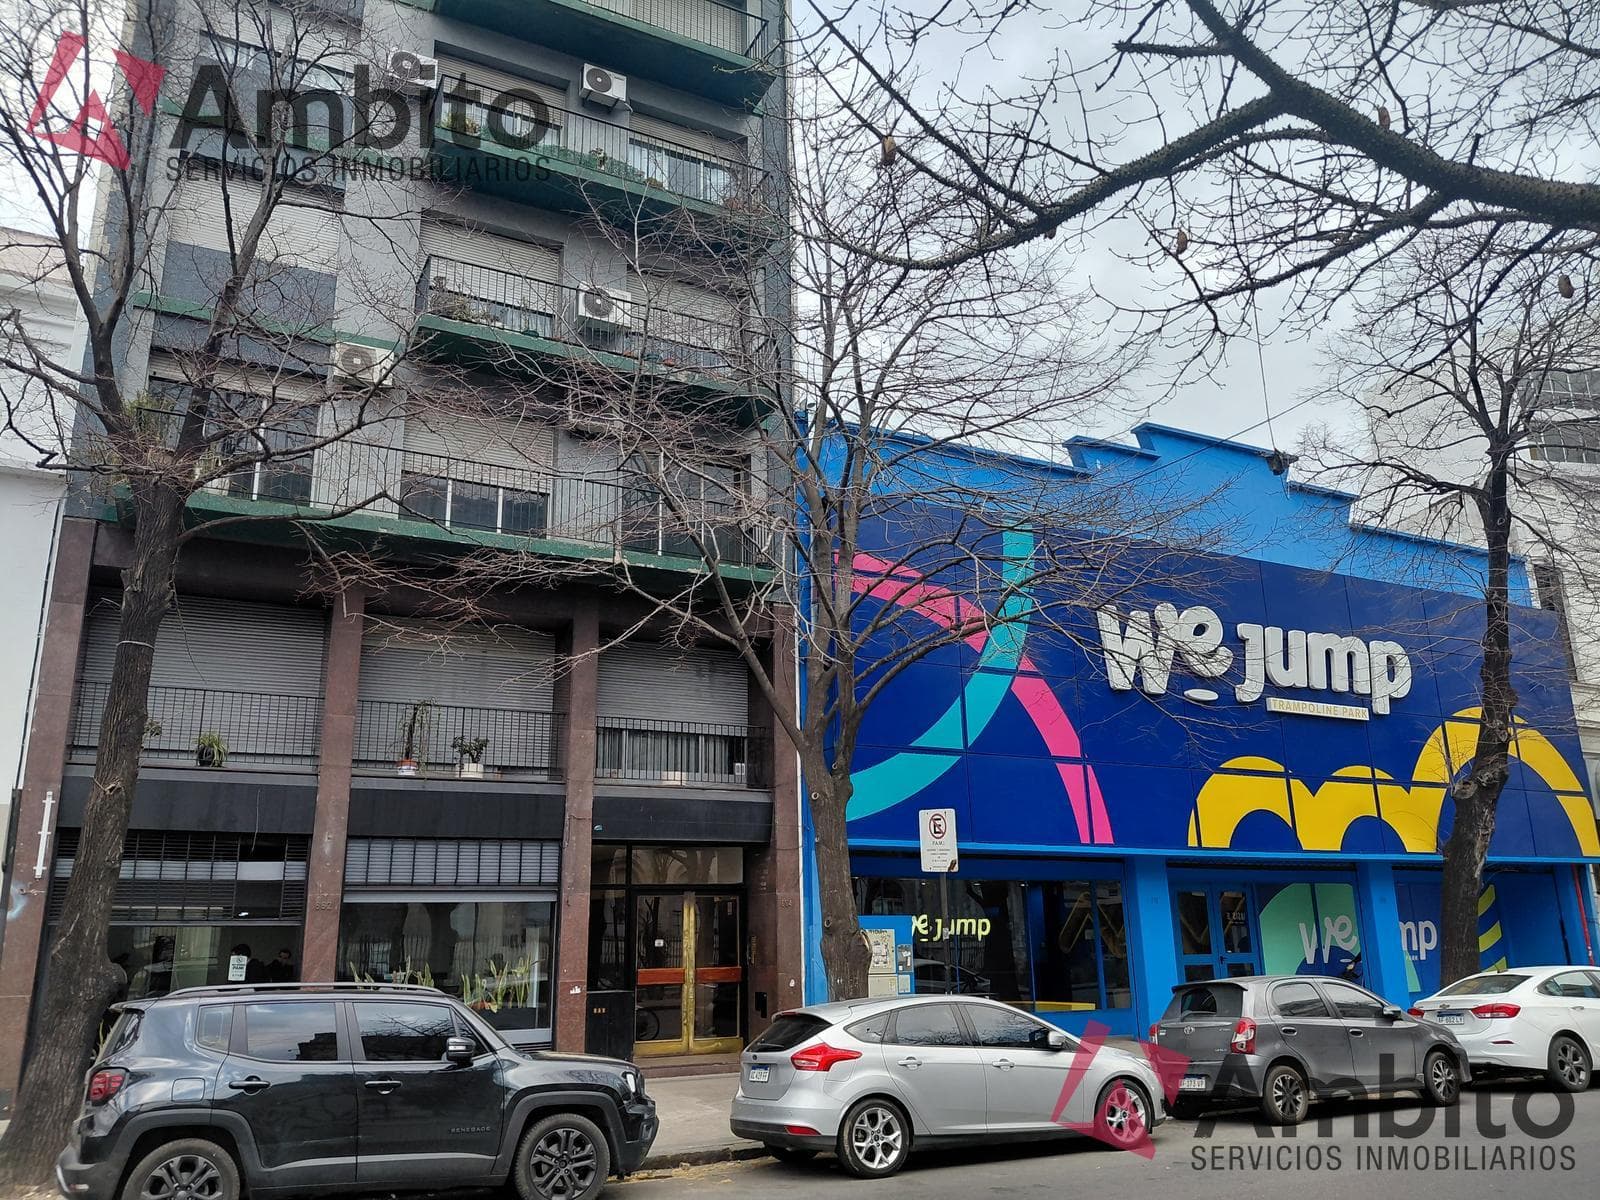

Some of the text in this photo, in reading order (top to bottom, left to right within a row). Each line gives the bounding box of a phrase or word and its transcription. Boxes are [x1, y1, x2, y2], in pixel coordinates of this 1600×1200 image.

[1234, 622, 1413, 716] jump
[1271, 700, 1369, 720] TRAMPOLINE PARK
